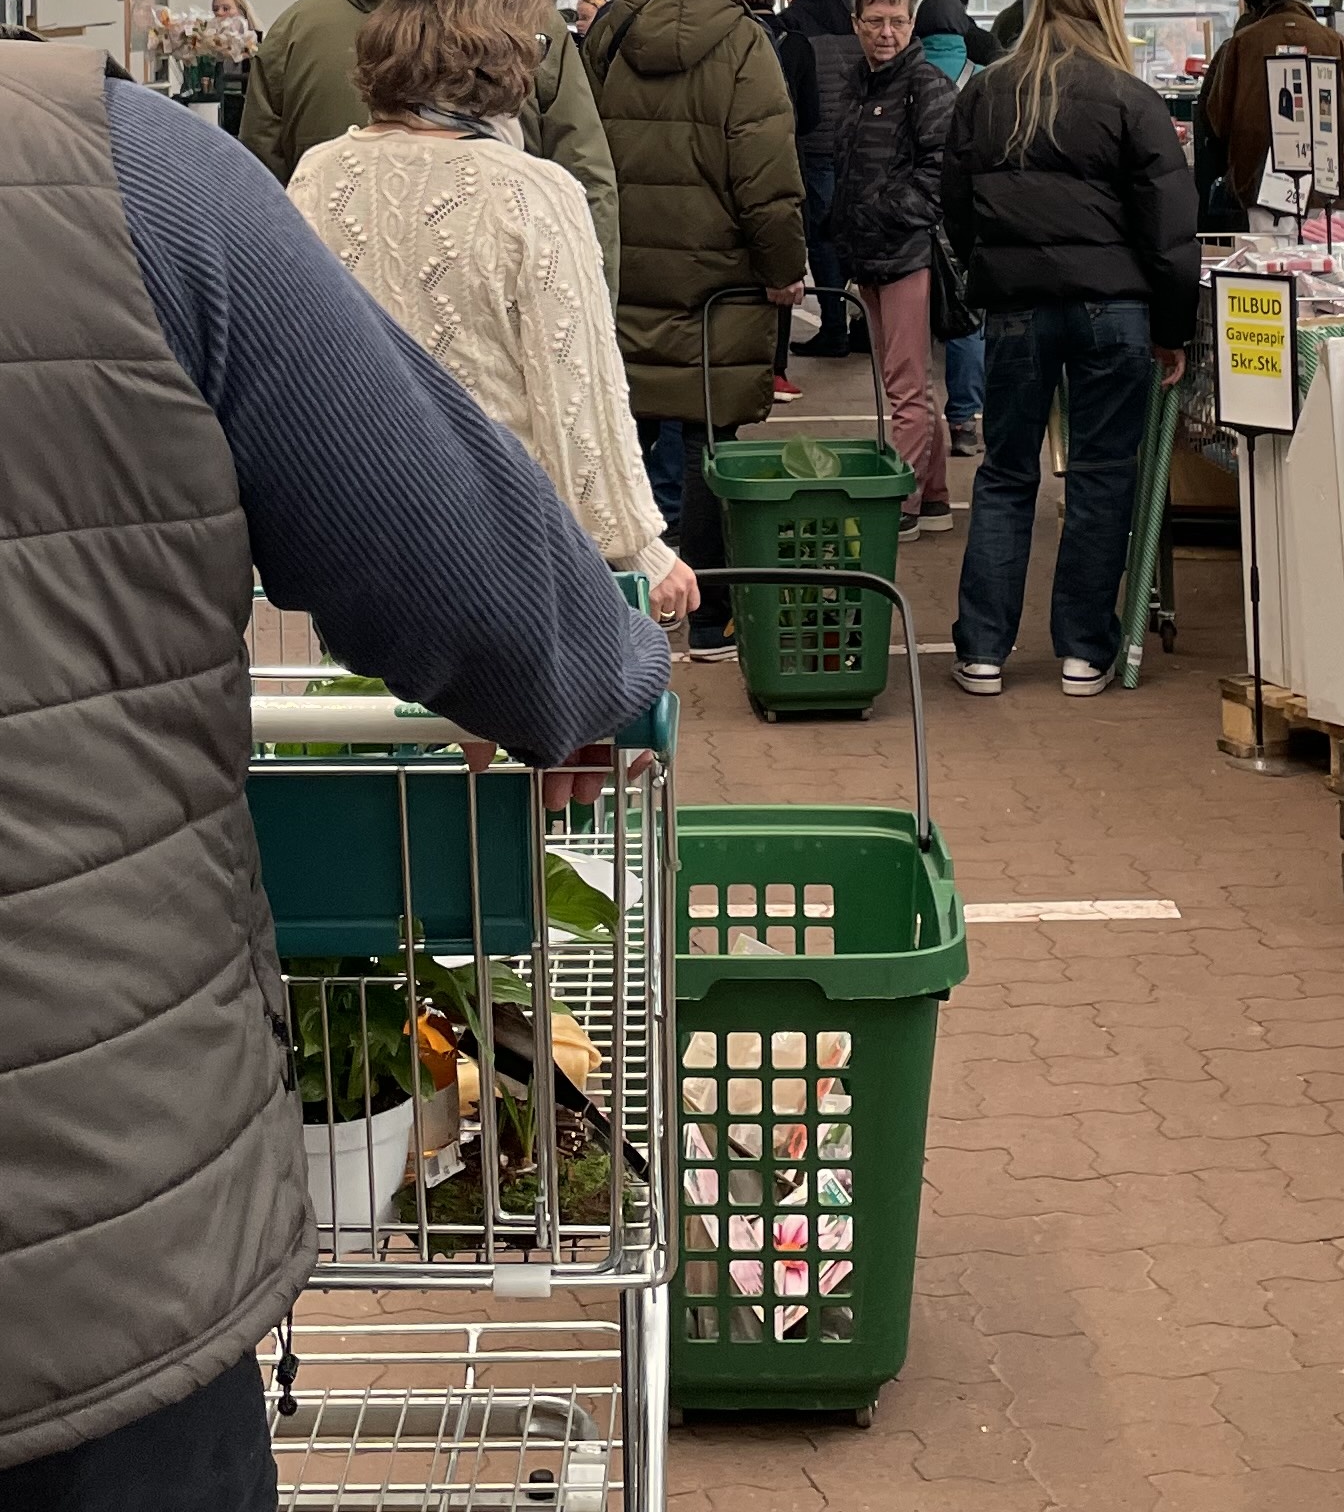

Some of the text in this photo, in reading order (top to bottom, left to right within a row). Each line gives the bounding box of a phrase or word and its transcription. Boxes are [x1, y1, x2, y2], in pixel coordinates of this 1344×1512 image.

[1228, 295, 1282, 316] TILBUD
[1226, 327, 1285, 347] Gavepapir
[1231, 352, 1282, 373] 5kr.Stk.
